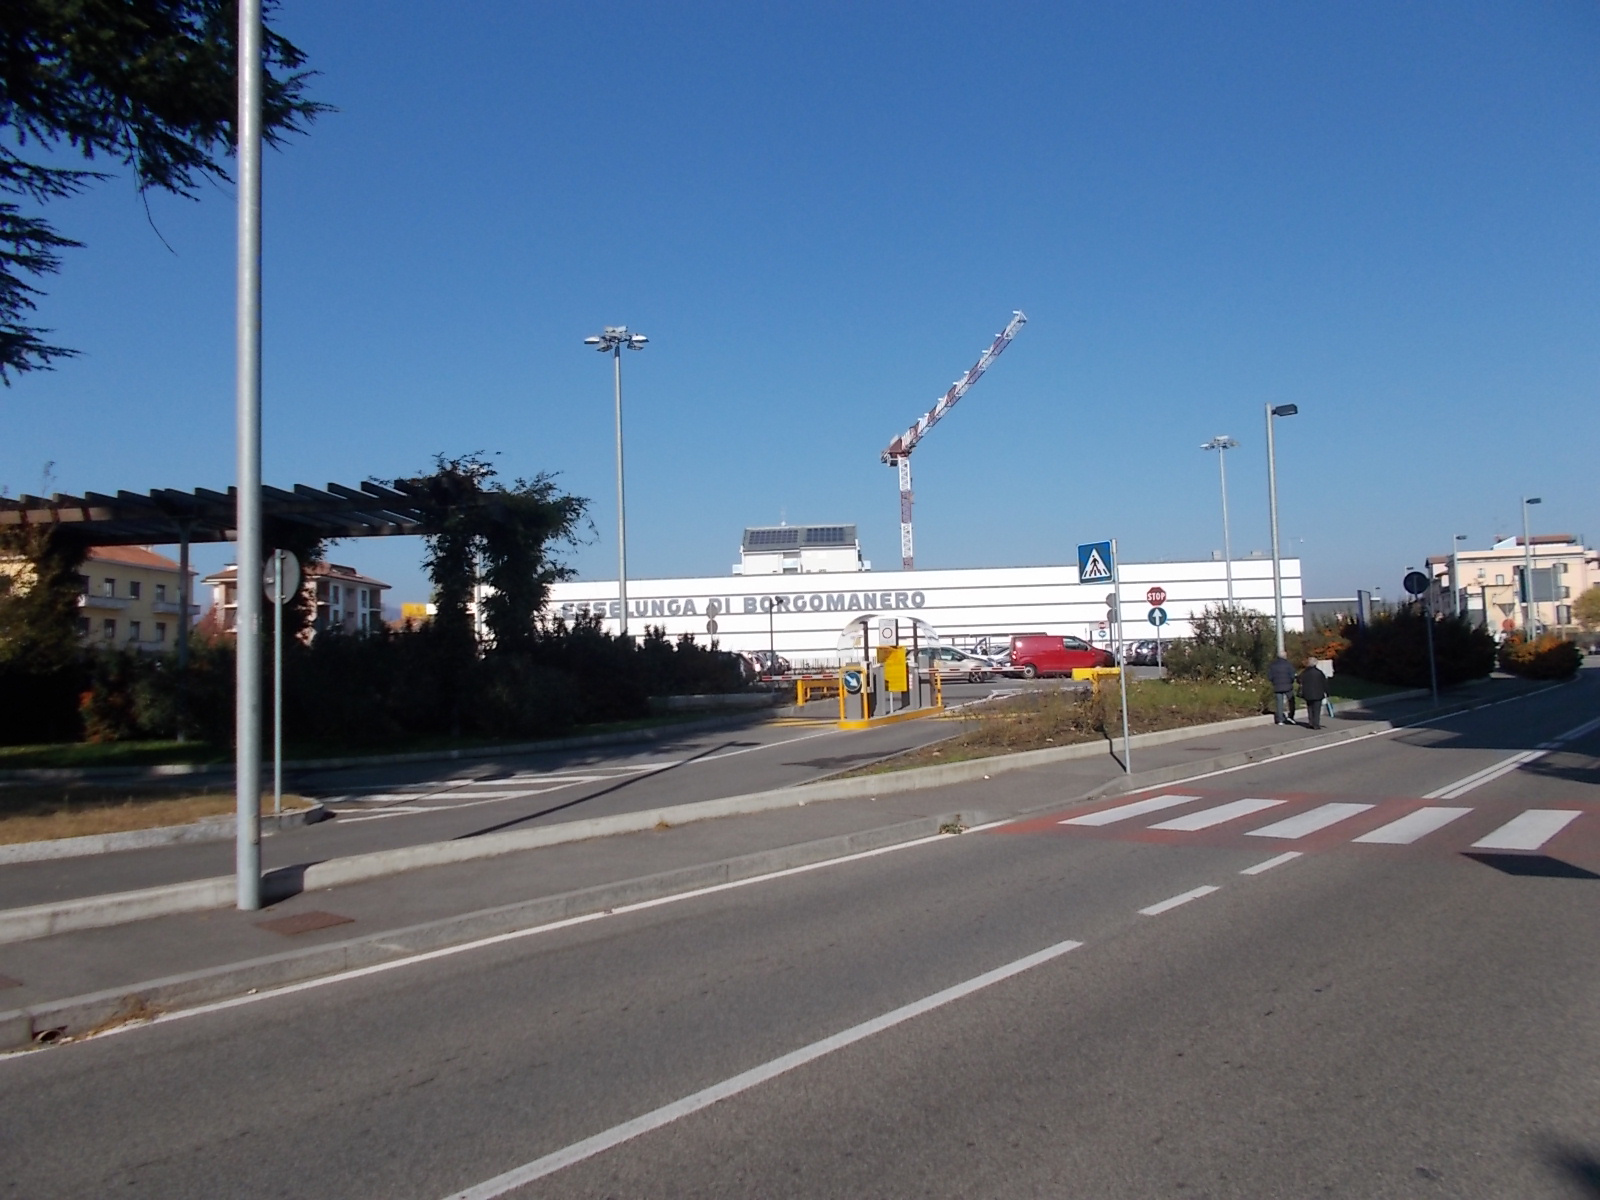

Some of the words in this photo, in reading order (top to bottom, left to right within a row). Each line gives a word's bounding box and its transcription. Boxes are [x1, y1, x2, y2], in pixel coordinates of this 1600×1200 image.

[708, 597, 731, 614] DI
[743, 591, 925, 614] BORGOMANERO
[1147, 592, 1166, 601] STOP
